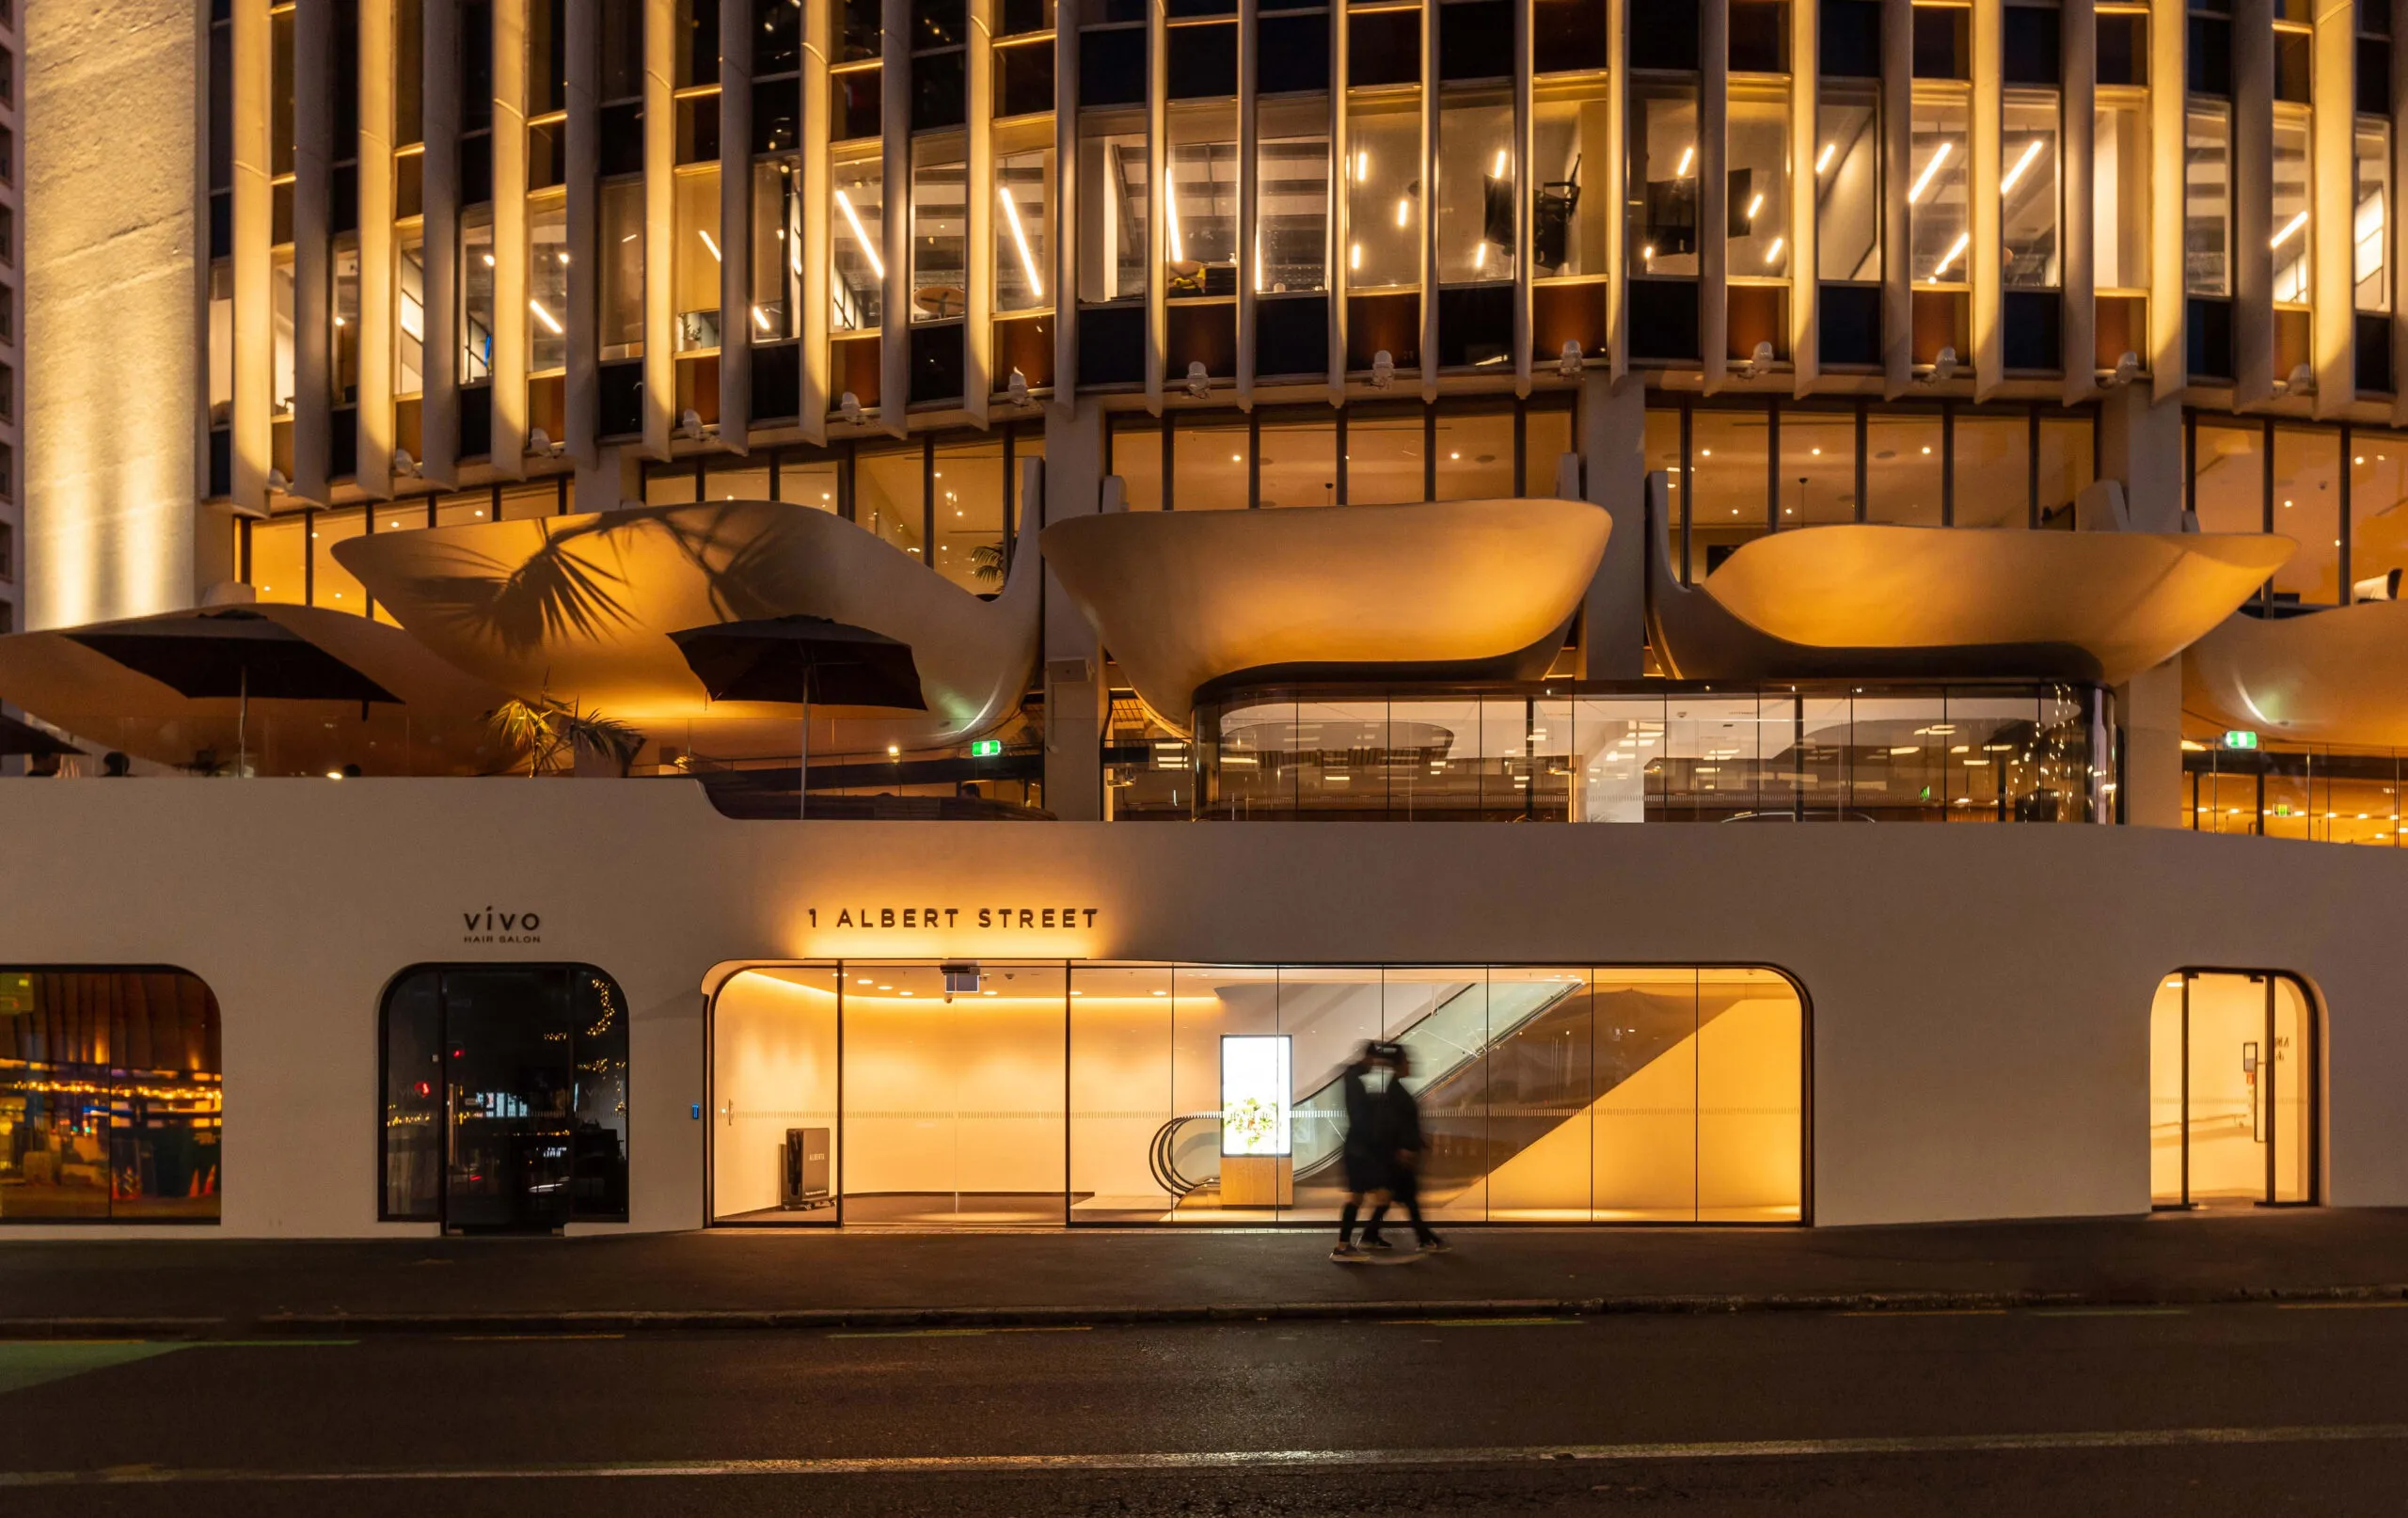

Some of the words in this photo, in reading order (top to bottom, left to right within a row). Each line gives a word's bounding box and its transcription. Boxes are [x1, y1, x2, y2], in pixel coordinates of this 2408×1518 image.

[808, 909, 816, 927] 1
[836, 909, 958, 928] ALBERT
[978, 909, 1098, 928] STREET
